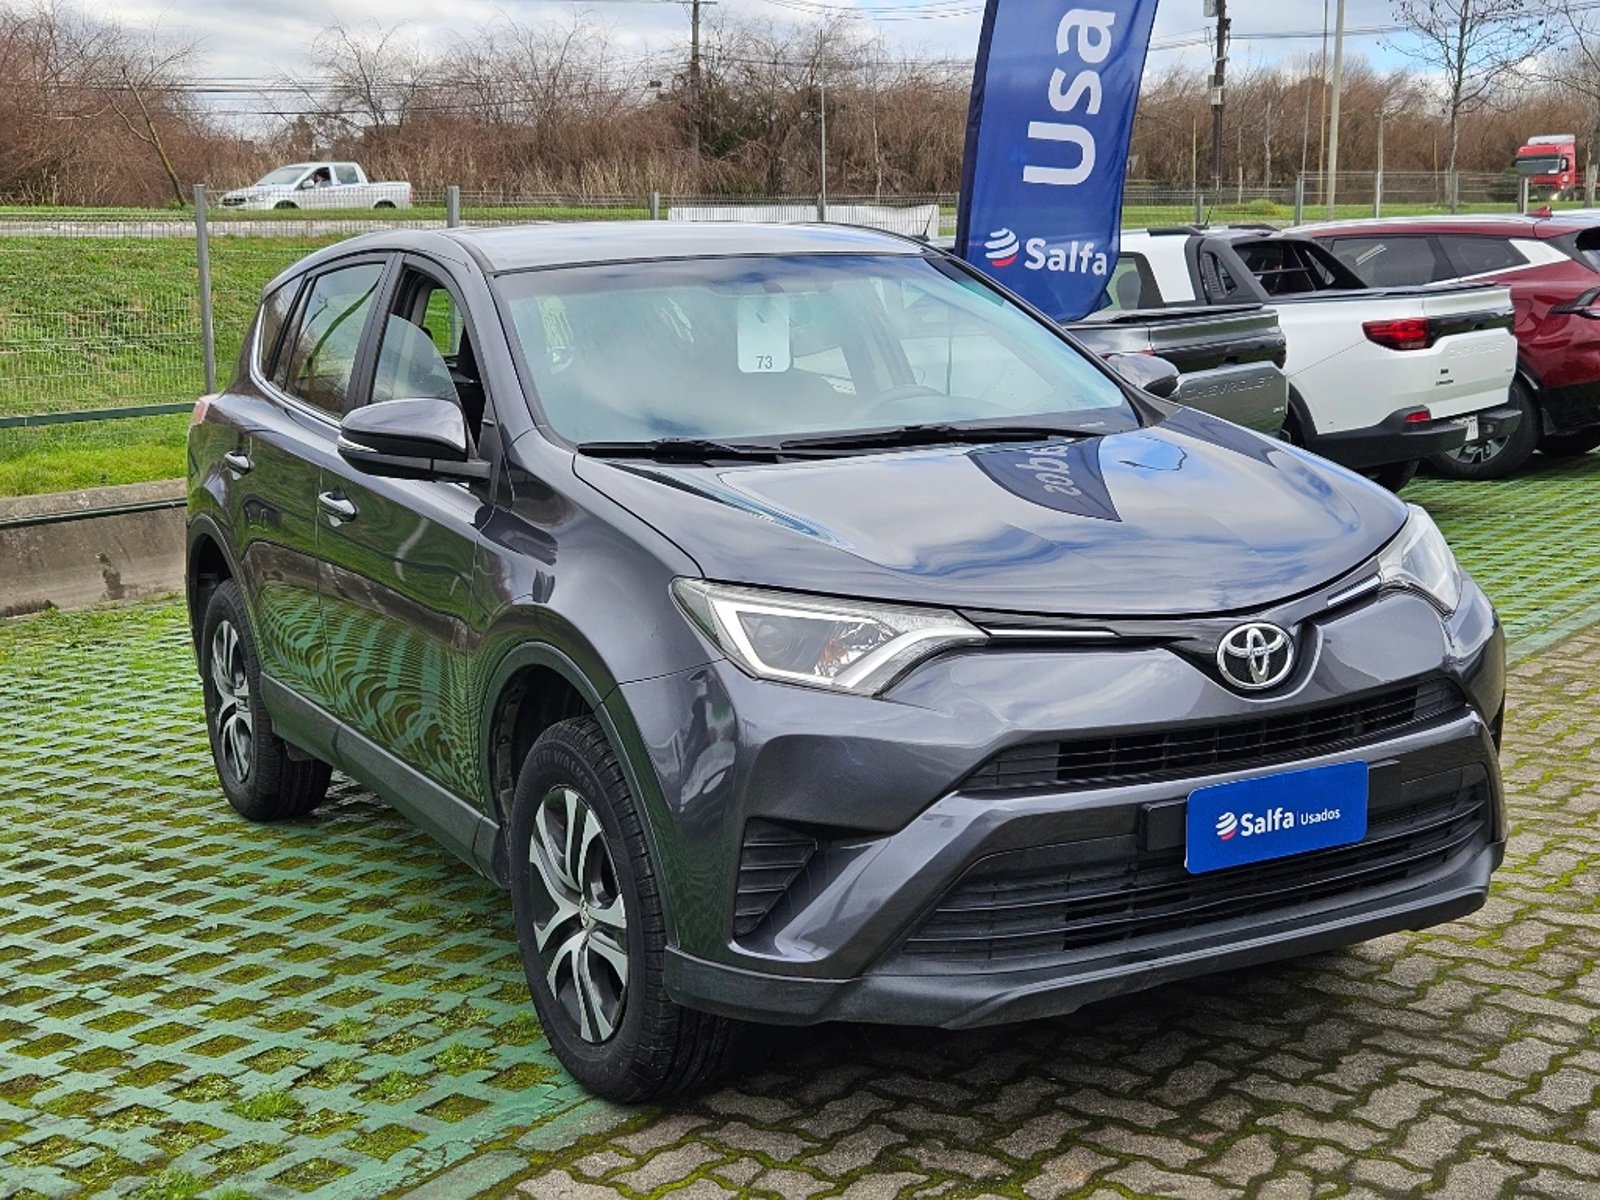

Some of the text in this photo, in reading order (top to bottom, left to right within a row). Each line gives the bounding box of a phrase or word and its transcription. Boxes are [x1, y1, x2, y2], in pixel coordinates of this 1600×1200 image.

[1022, 8, 1116, 186] Usa
[1024, 238, 1108, 276] Salfa
[756, 355, 773, 369] 73
[1240, 807, 1341, 837] Salfa Usados
